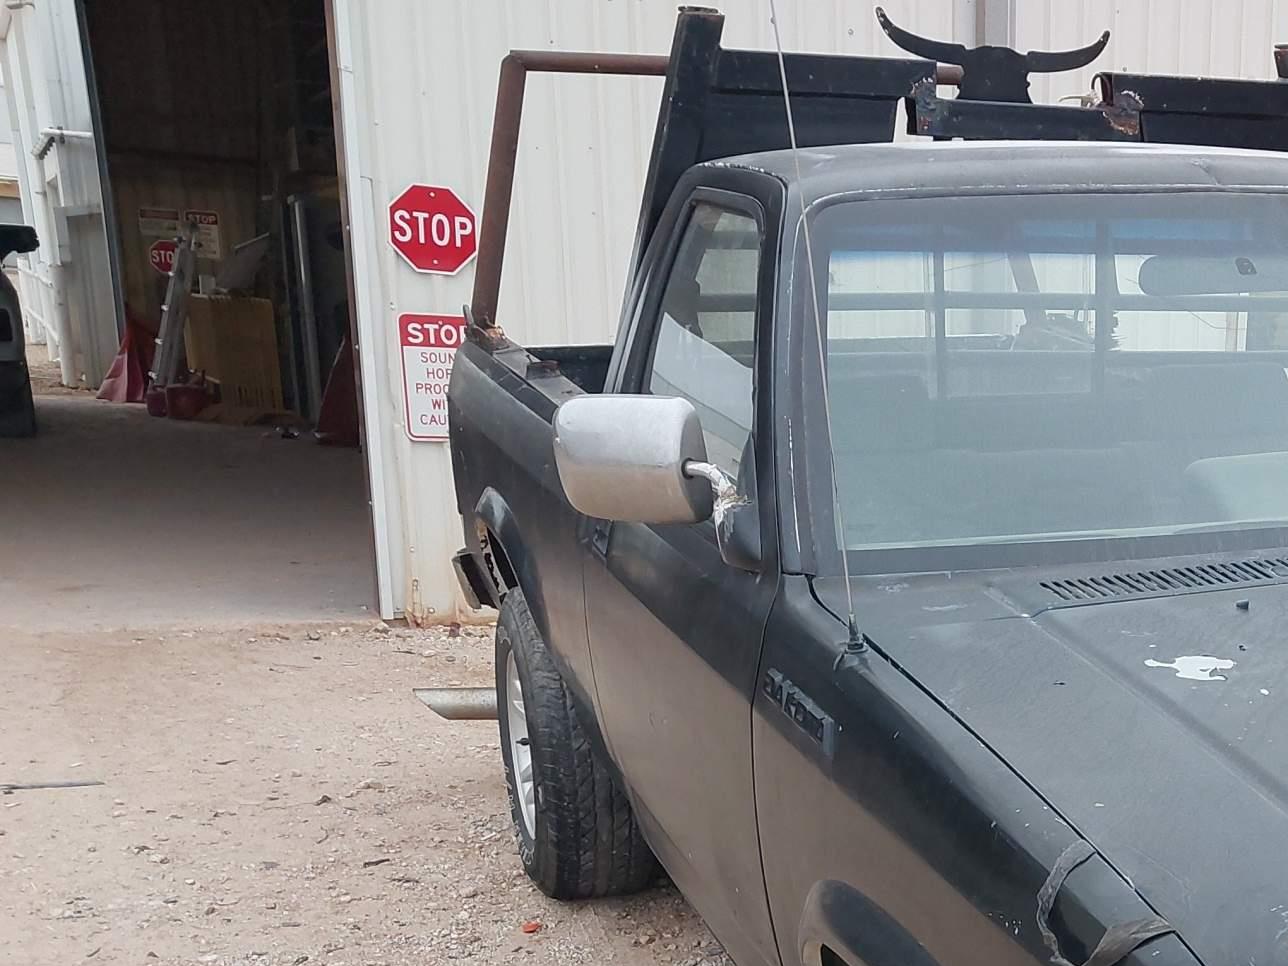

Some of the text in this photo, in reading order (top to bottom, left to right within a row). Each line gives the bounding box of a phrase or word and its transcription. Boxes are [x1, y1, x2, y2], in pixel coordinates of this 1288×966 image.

[394, 209, 472, 248] STOP
[152, 250, 174, 263] STO
[420, 352, 456, 364] SOUN
[416, 383, 449, 395] PROC
